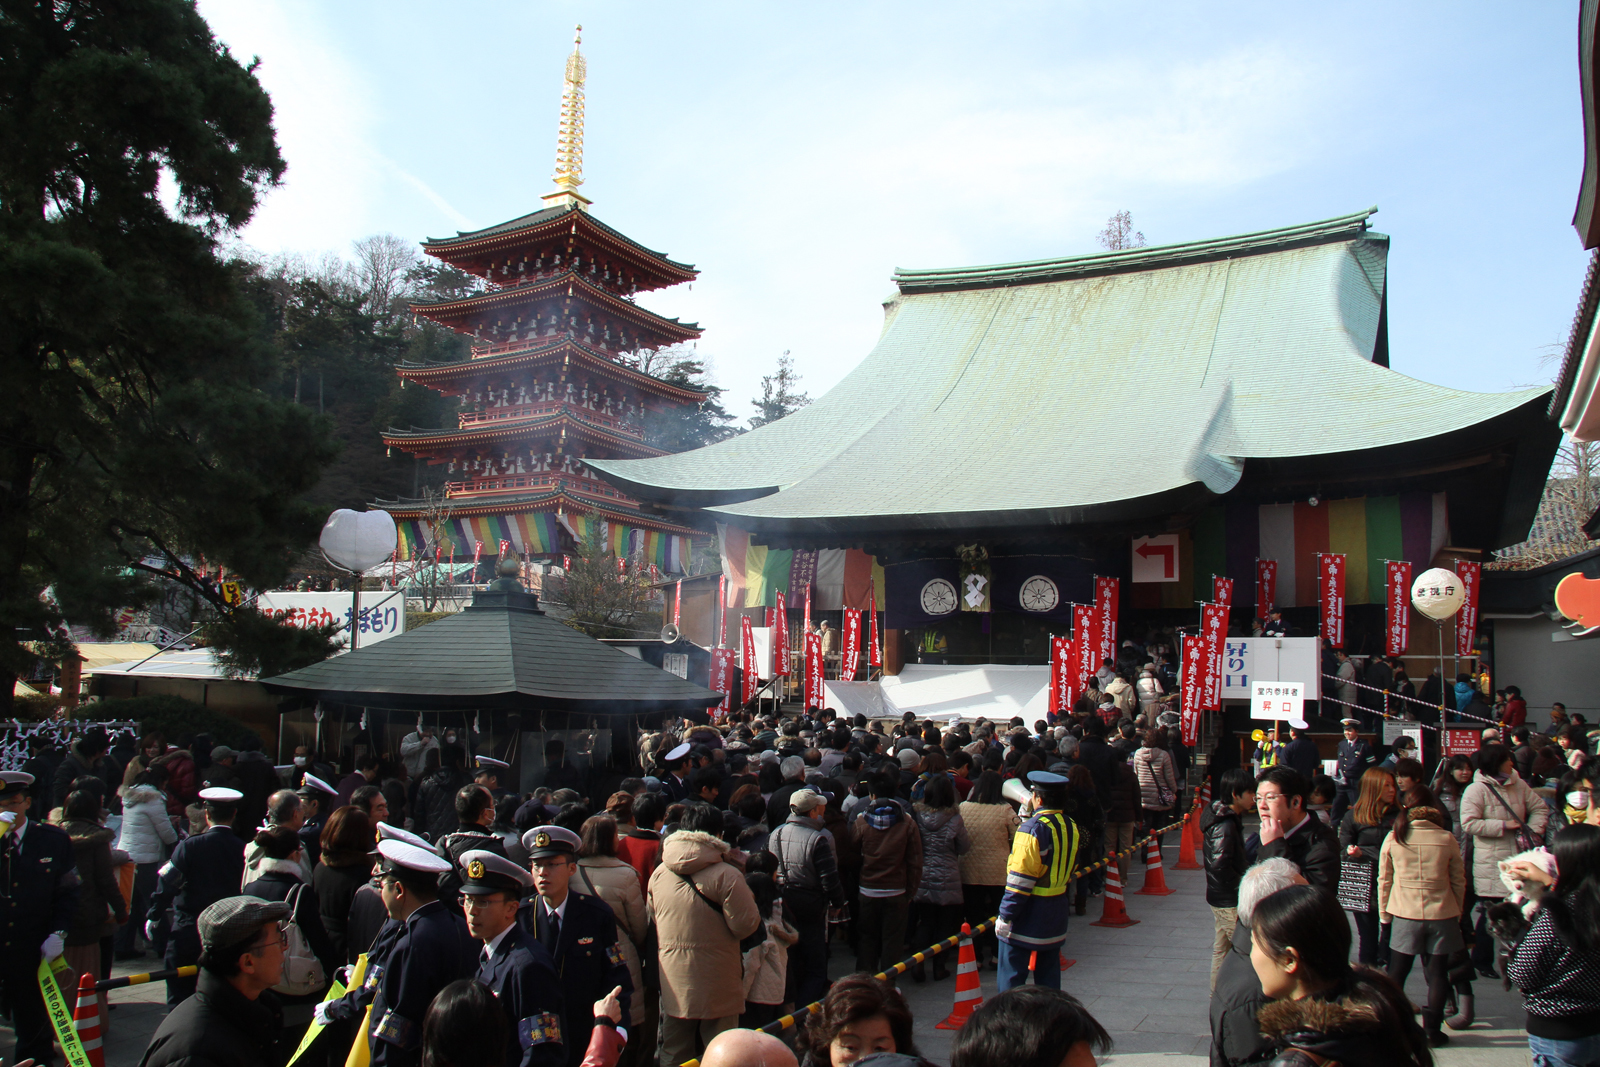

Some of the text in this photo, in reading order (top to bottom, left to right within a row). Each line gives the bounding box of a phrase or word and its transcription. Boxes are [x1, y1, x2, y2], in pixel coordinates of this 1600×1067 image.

[1225, 642, 1248, 688] 昇り口
[1262, 700, 1292, 712] 昇口
